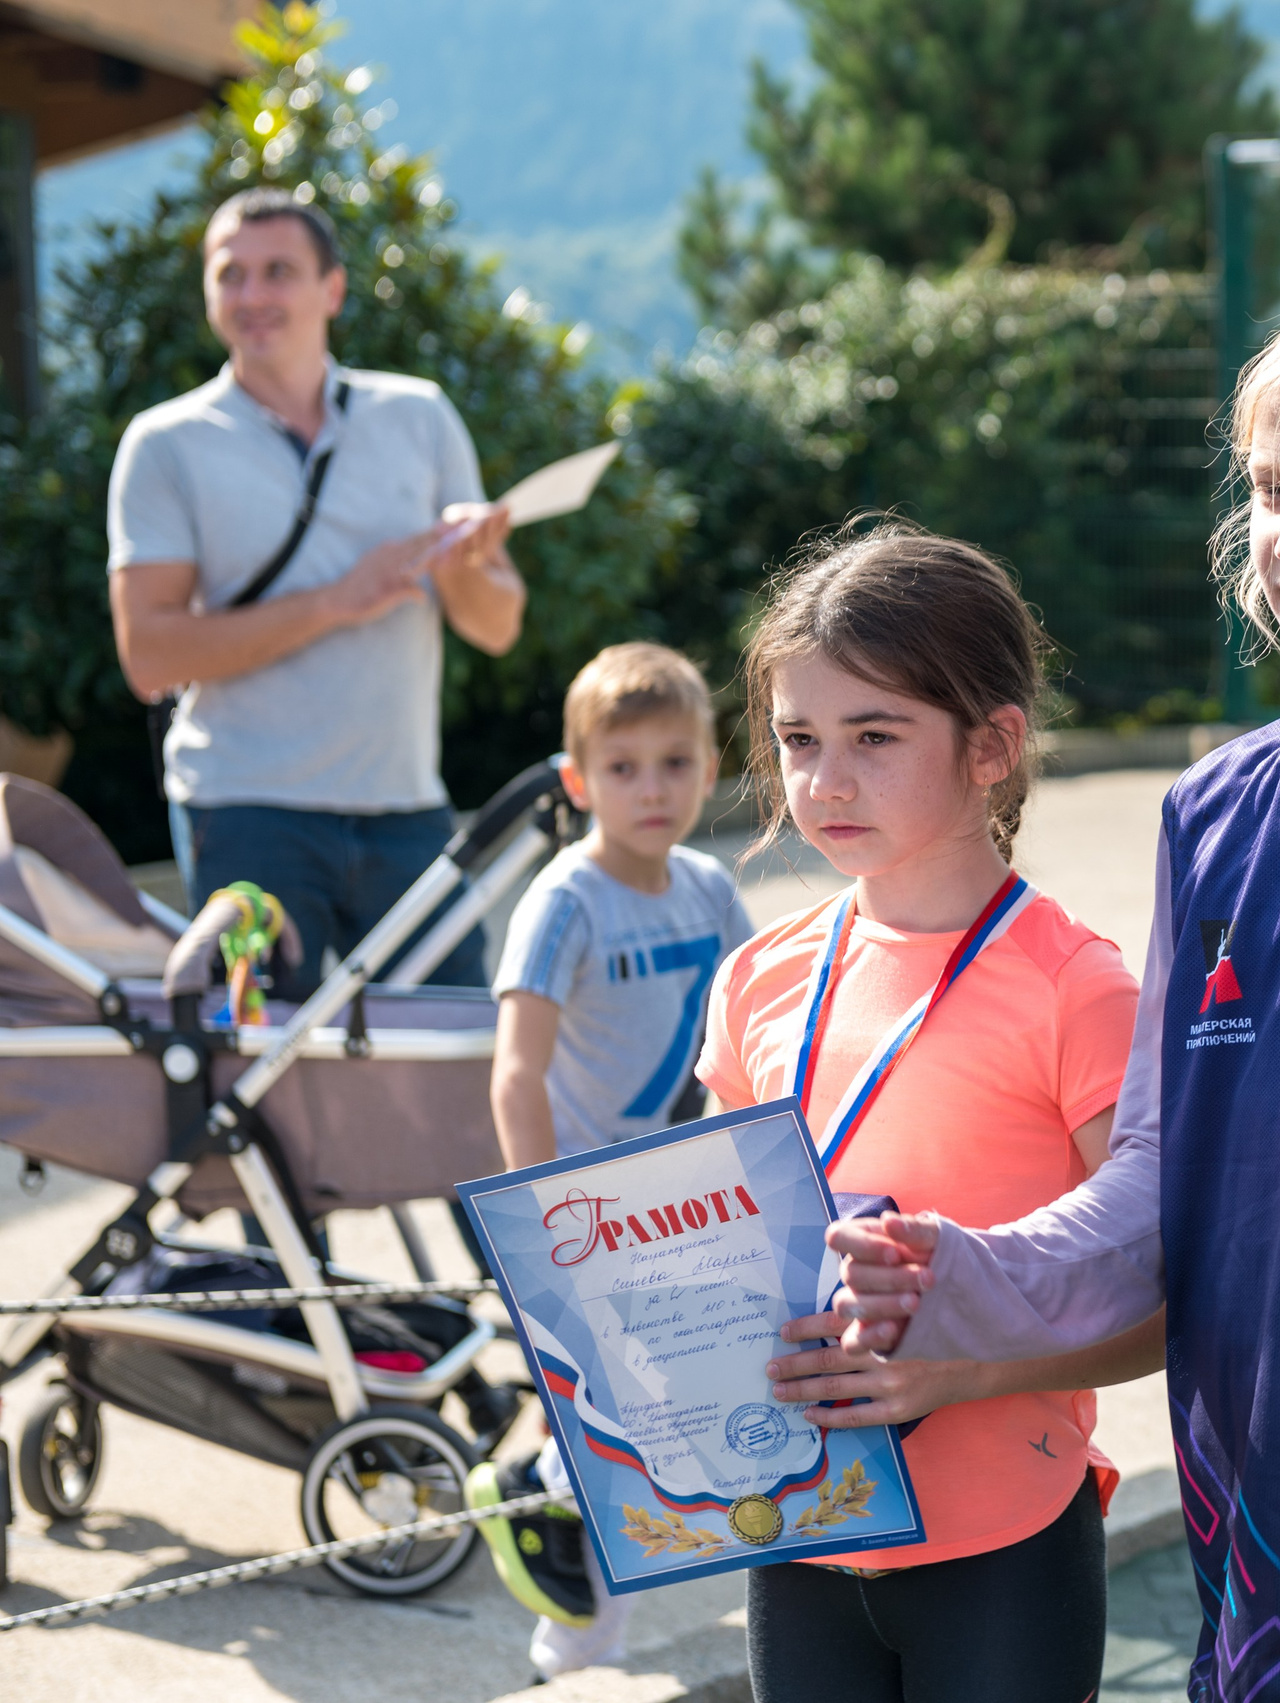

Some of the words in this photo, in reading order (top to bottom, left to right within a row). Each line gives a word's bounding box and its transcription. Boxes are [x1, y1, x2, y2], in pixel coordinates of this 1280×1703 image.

[621, 931, 721, 1118] 7
[645, 1295, 661, 1310] за
[647, 1336, 661, 1346] по
